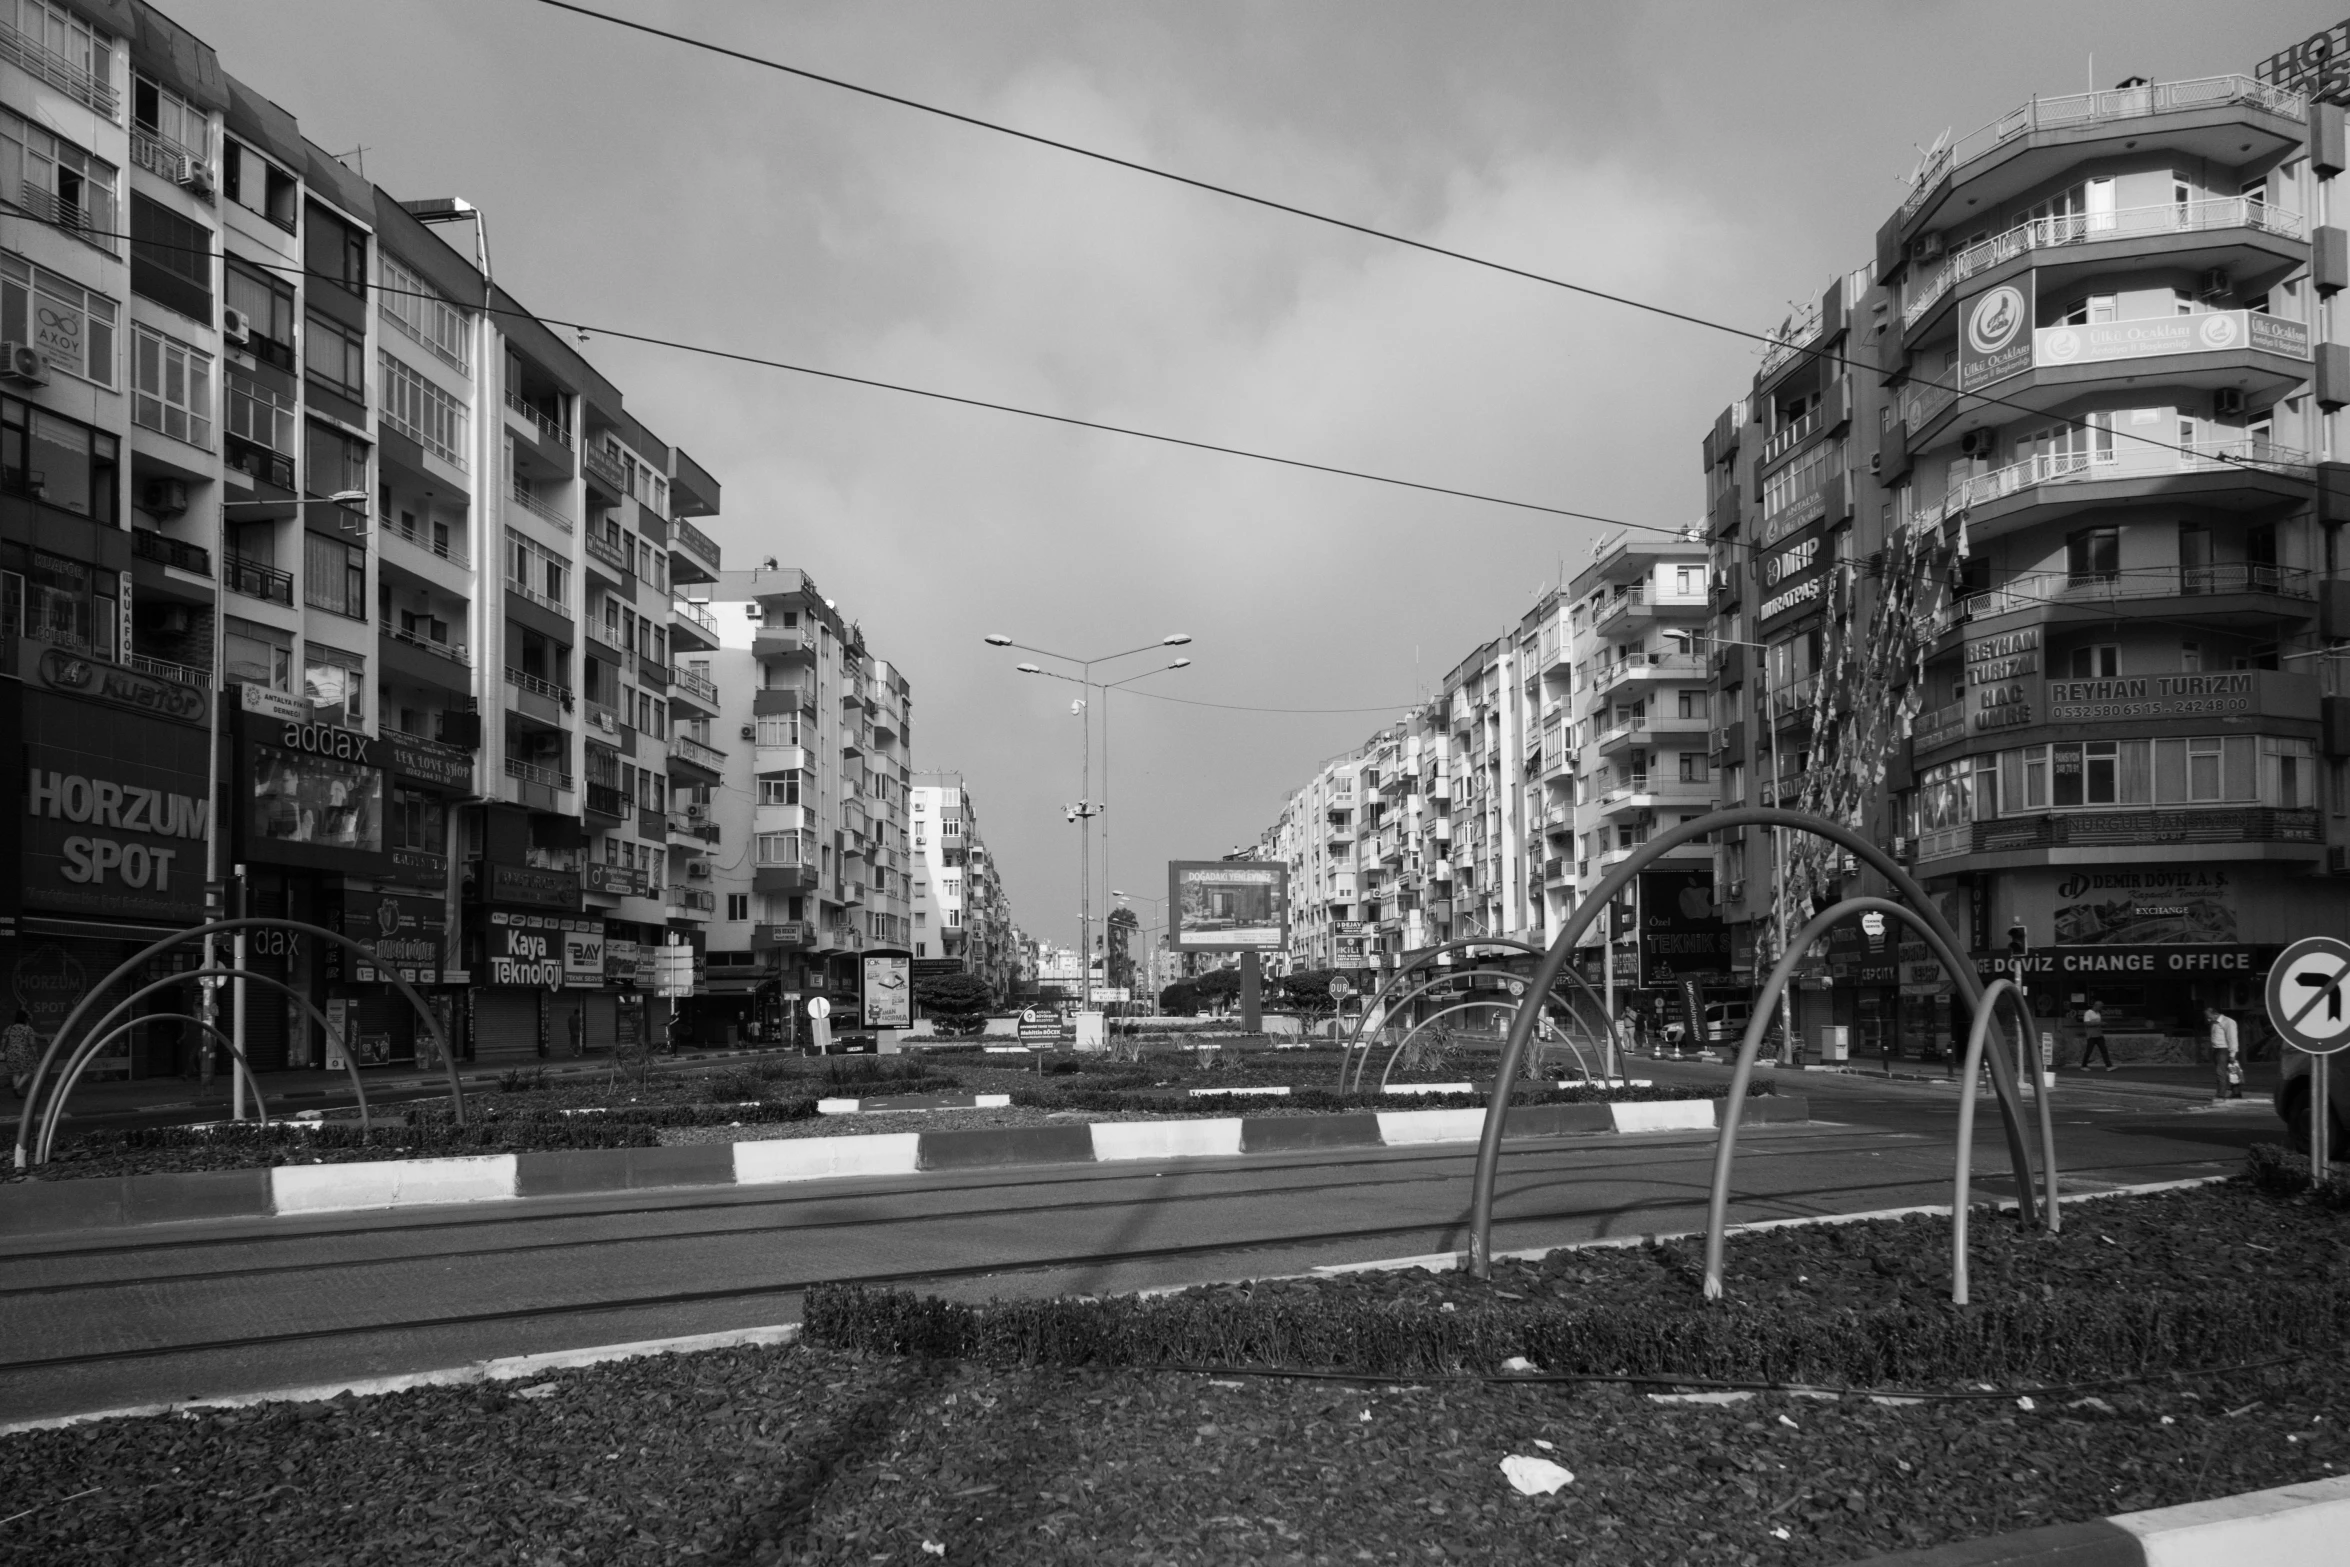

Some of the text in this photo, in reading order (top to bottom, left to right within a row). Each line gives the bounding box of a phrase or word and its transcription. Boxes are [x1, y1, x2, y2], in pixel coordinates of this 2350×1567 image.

[39, 328, 79, 353] AXOY
[1785, 491, 1821, 519] ANTALYA
[1781, 536, 1820, 579] MHP
[123, 586, 132, 665] KUAFÖR
[1966, 628, 2040, 664] REYHAN
[101, 671, 198, 715] Kuaför
[264, 693, 293, 707] ANTALYA
[1981, 684, 2024, 709] HAC
[2052, 678, 2148, 702] REYHAN
[1975, 703, 2032, 731] UMRE
[284, 721, 368, 764] addax
[406, 767, 421, 778] 0242
[418, 755, 443, 773] LOVE
[445, 761, 470, 779] SHOP
[28, 767, 210, 842] HORZUM
[60, 835, 176, 893] SPOT
[1188, 870, 1228, 881] DOĞADAKİ
[2092, 870, 2141, 889] DEMİR
[2144, 867, 2192, 888] DÖVİZ
[1649, 915, 1671, 927] Özel
[2135, 905, 2190, 916] EXCHANGE
[506, 929, 548, 962] Kaya
[2062, 954, 2155, 972] CHANGE
[2167, 952, 2250, 970] OFFICE
[19, 973, 80, 990] HORZUM
[489, 956, 562, 993] Teknoloji
[566, 973, 584, 983] TEKNİK
[1330, 983, 1348, 993] DUR
[34, 1001, 67, 1013] SPOT
